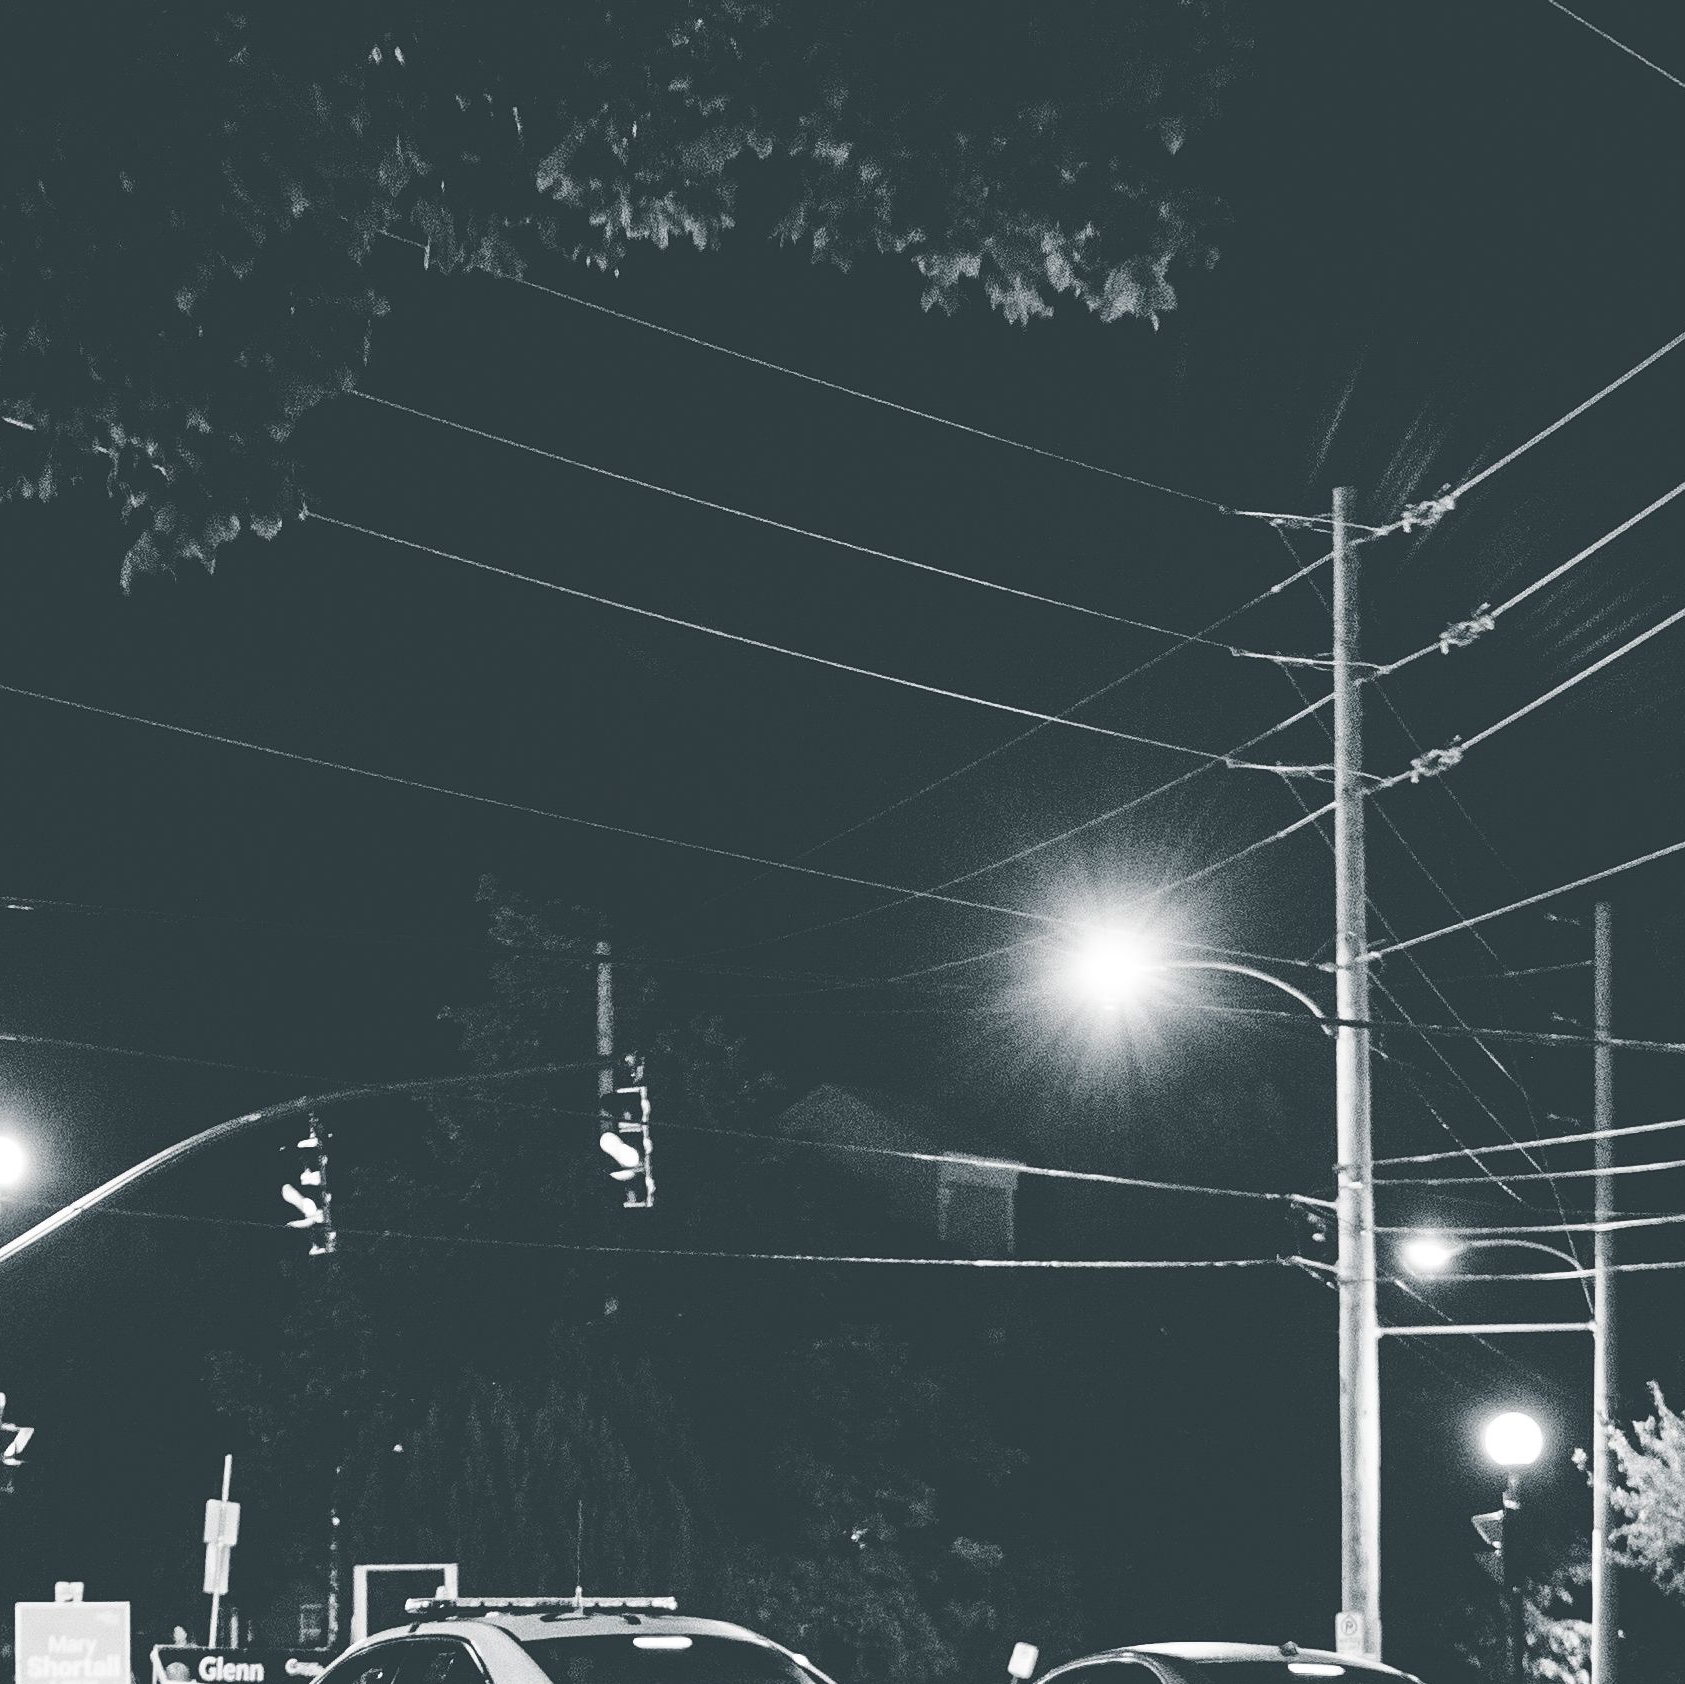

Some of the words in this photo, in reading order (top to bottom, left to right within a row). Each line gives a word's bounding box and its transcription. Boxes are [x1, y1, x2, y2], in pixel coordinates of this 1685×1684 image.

[48, 1635, 98, 1658] Mary
[27, 1654, 121, 1678] Shortall
[198, 1656, 265, 1682] Glenn
